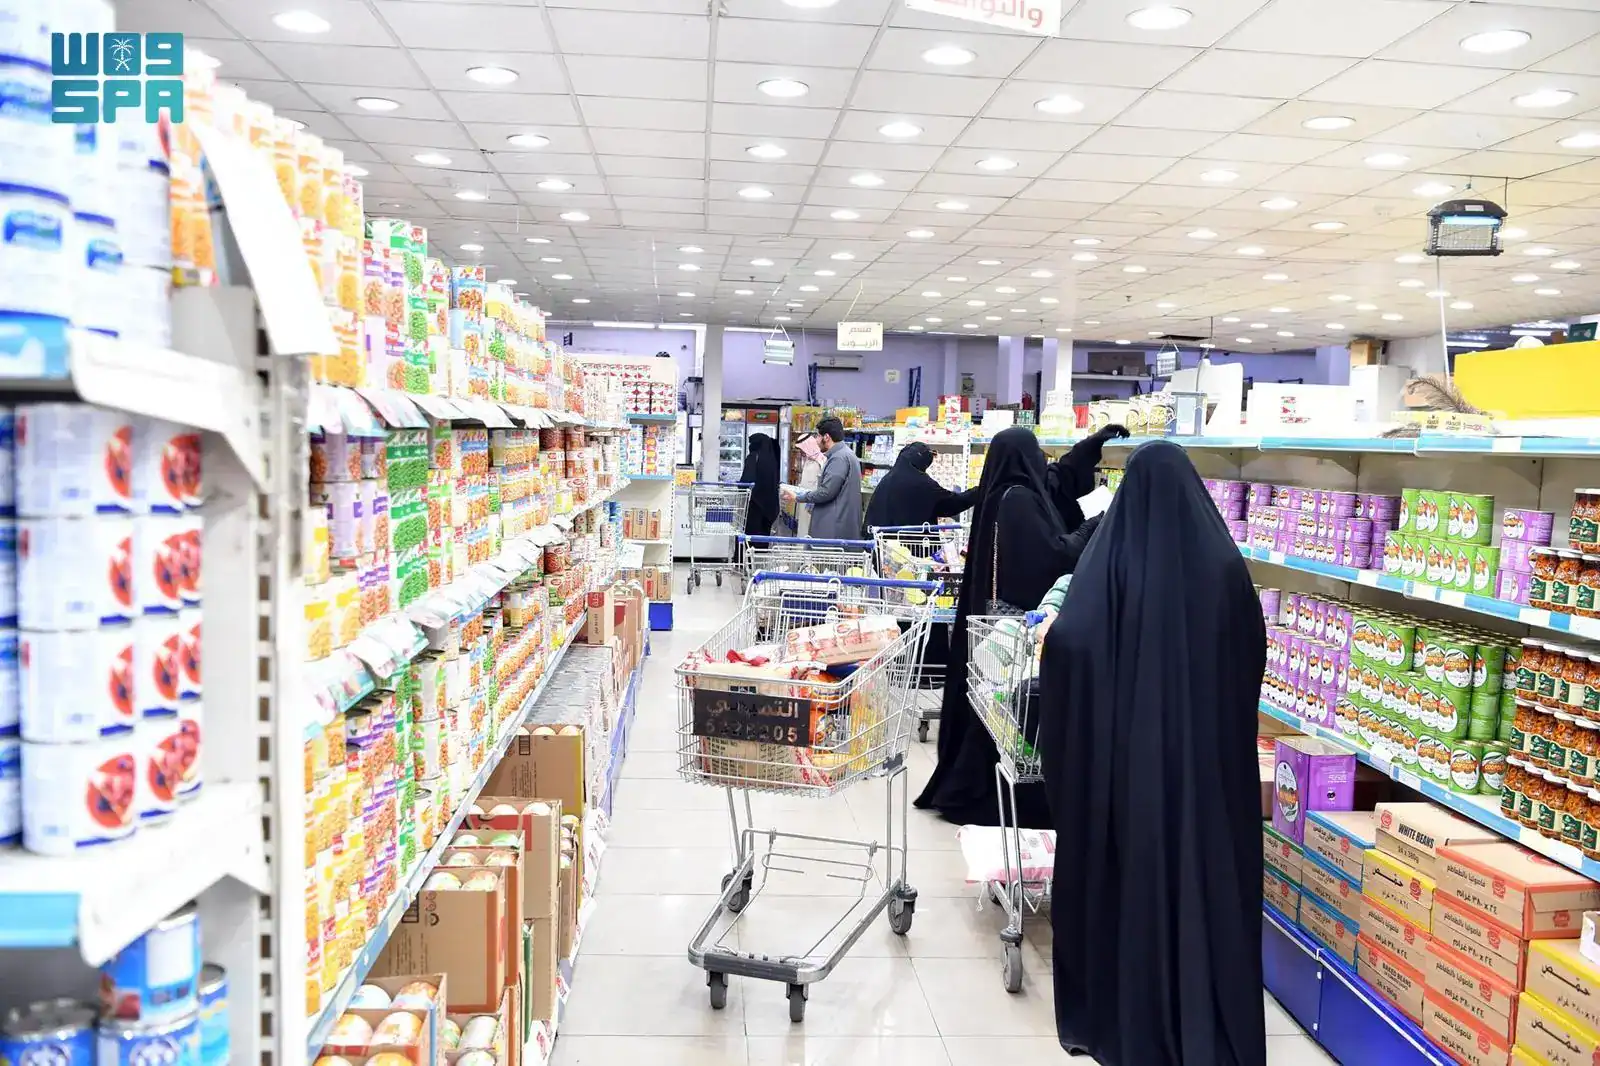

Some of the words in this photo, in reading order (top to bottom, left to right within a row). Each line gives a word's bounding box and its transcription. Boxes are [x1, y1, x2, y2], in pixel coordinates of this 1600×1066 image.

[1398, 823, 1416, 841] WHITE
[1415, 831, 1435, 849] BEANS
[1396, 973, 1412, 989] BEANS
